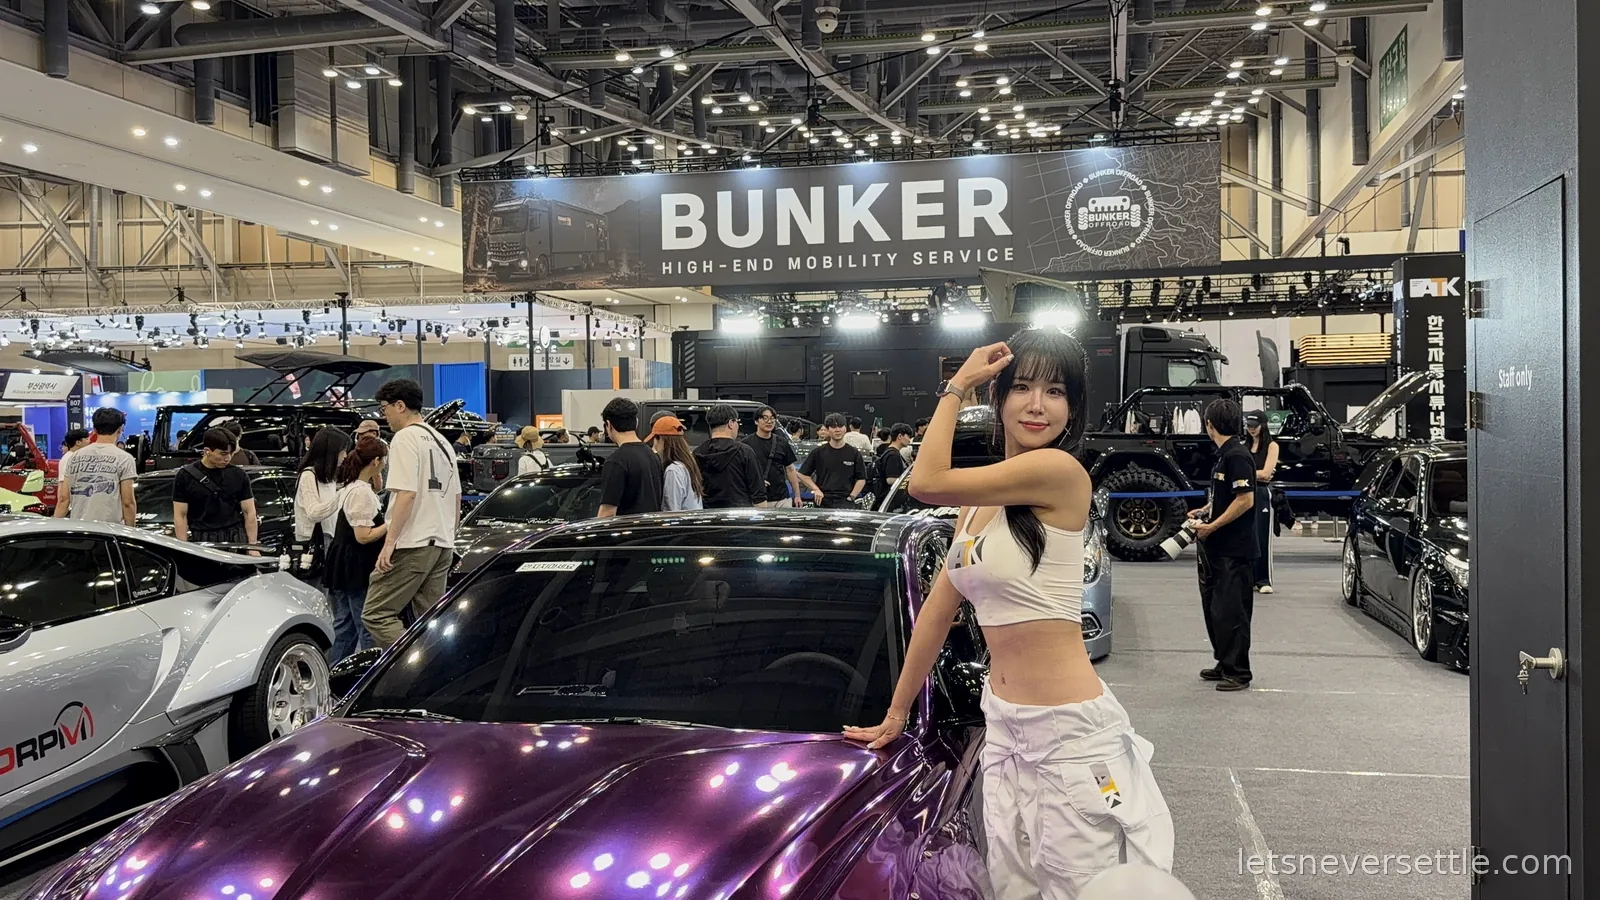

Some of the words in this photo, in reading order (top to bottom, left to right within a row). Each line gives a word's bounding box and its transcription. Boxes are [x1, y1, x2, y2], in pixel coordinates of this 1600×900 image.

[1088, 168, 1115, 180] BUNKER
[1115, 169, 1143, 186] OFFROAD
[1065, 181, 1083, 209] OFFROAD
[1144, 190, 1155, 217] BUNKER
[660, 177, 1013, 250] BUNKER
[1065, 209, 1076, 235] BUNKER
[1088, 212, 1130, 222] BUNKER
[1088, 220, 1130, 229] OFFROAD
[1135, 217, 1155, 244] OFFROAD
[662, 258, 774, 274] HIGH-END
[788, 253, 898, 270] MOBILITY
[913, 248, 1015, 265] SERVICE
[1076, 239, 1103, 257] OFFROAD
[1103, 245, 1131, 257] BUNKER
[1410, 276, 1461, 298] ATK
[1498, 366, 1515, 388] Staff
[1516, 364, 1533, 391] only
